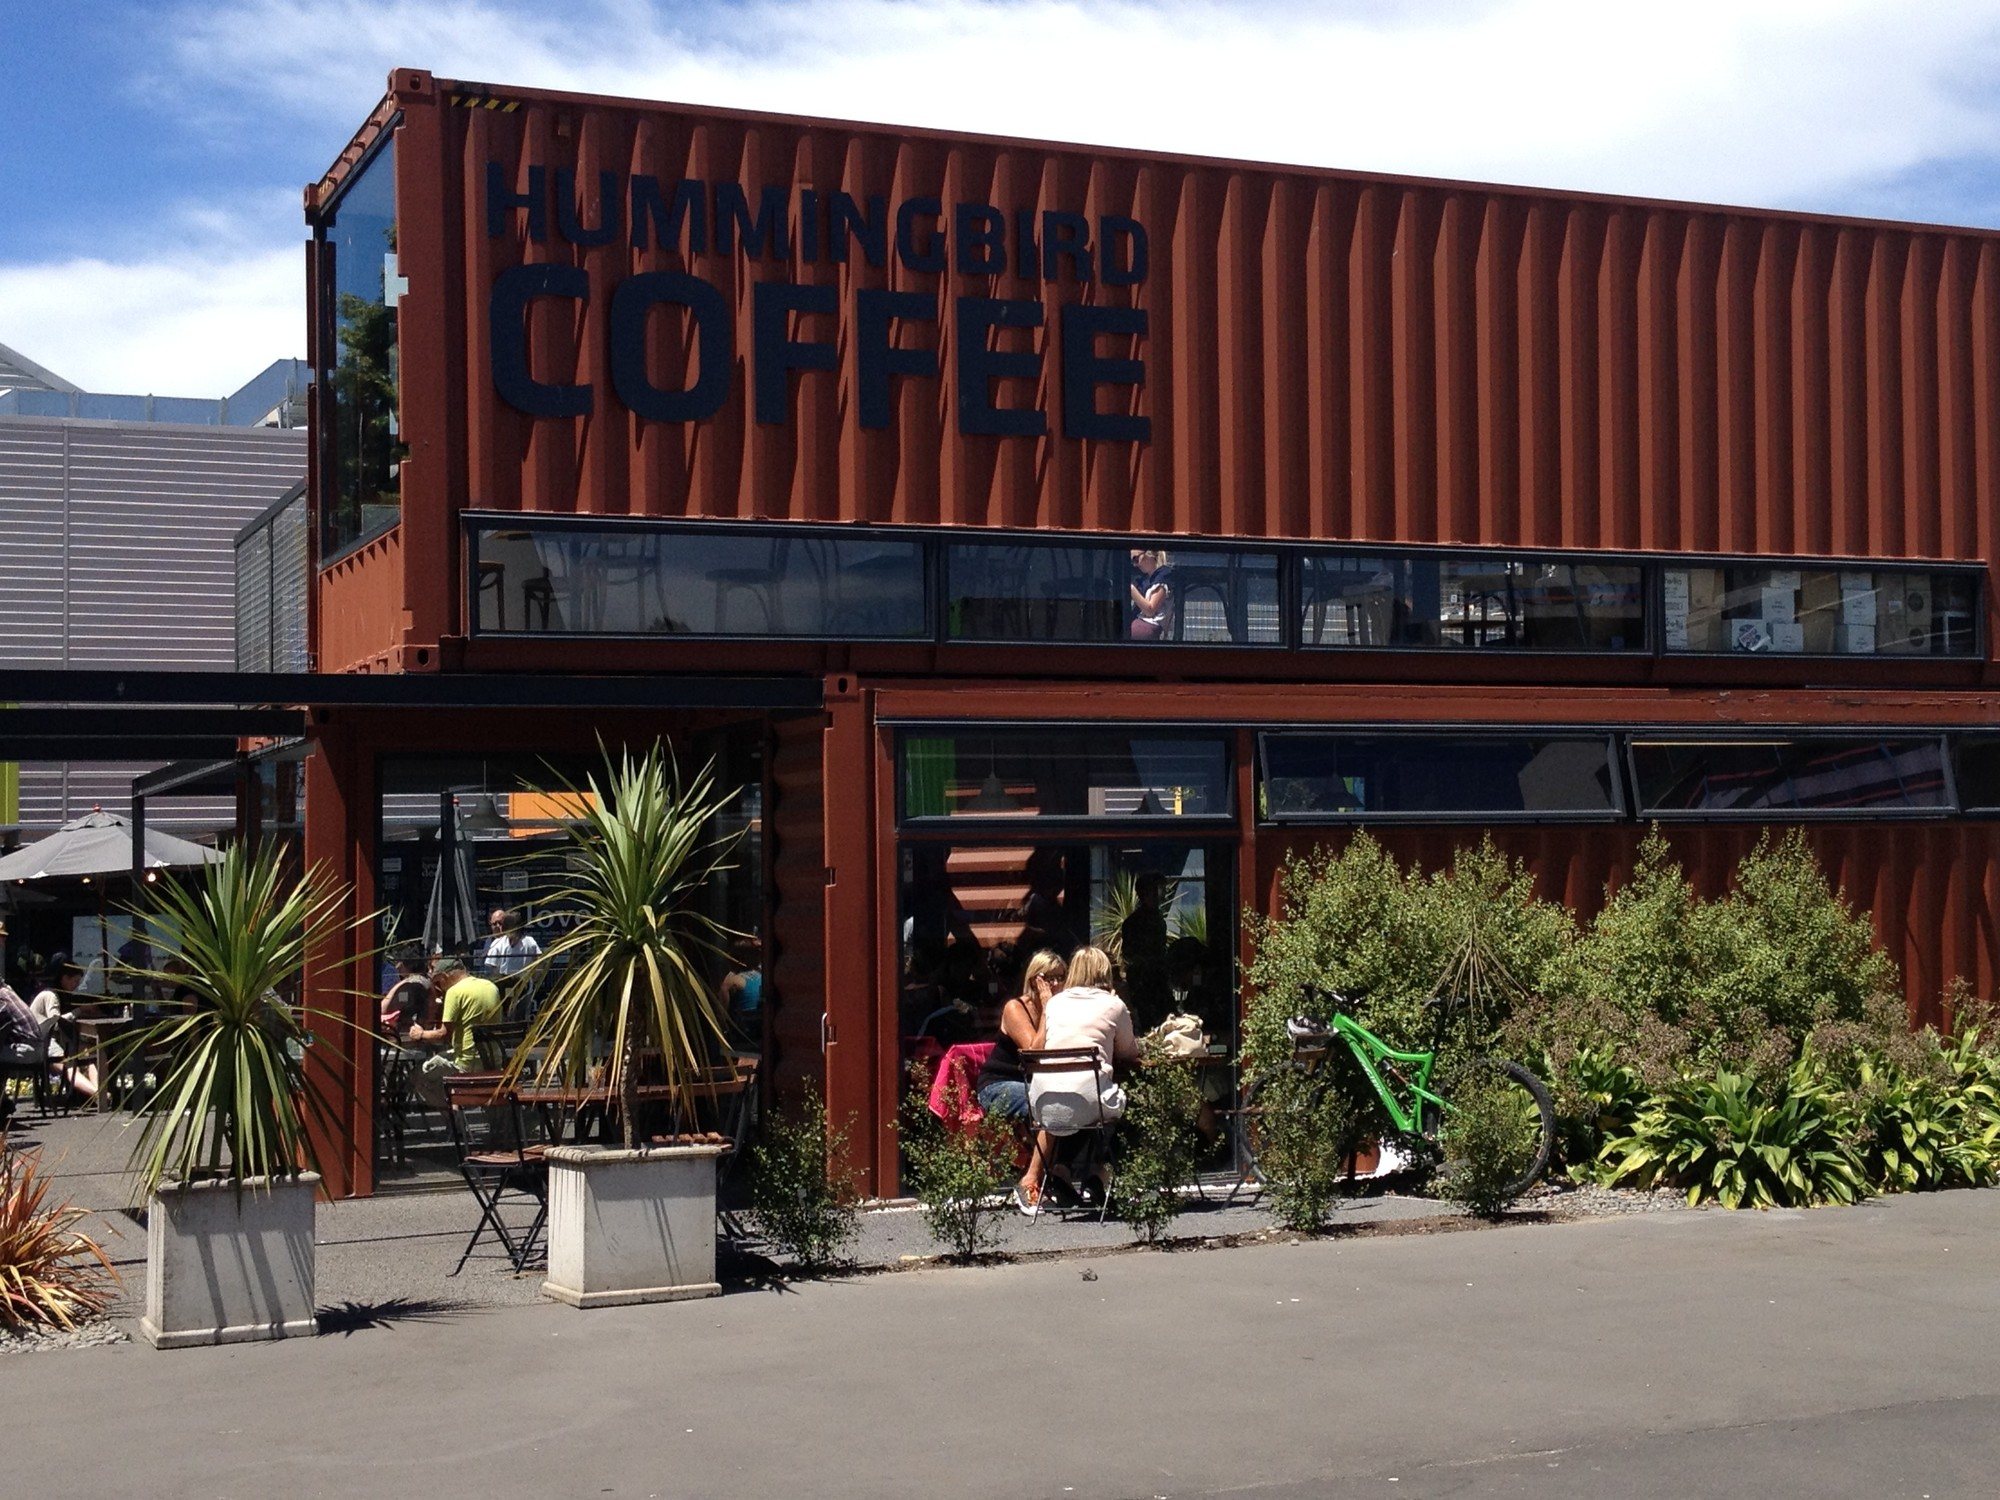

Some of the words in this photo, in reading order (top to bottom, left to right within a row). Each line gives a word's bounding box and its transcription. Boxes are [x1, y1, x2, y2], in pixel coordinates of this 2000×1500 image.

[487, 161, 1149, 286] HUMMINGBIRD
[490, 263, 1151, 441] COFFEE
[525, 902, 592, 928] love
